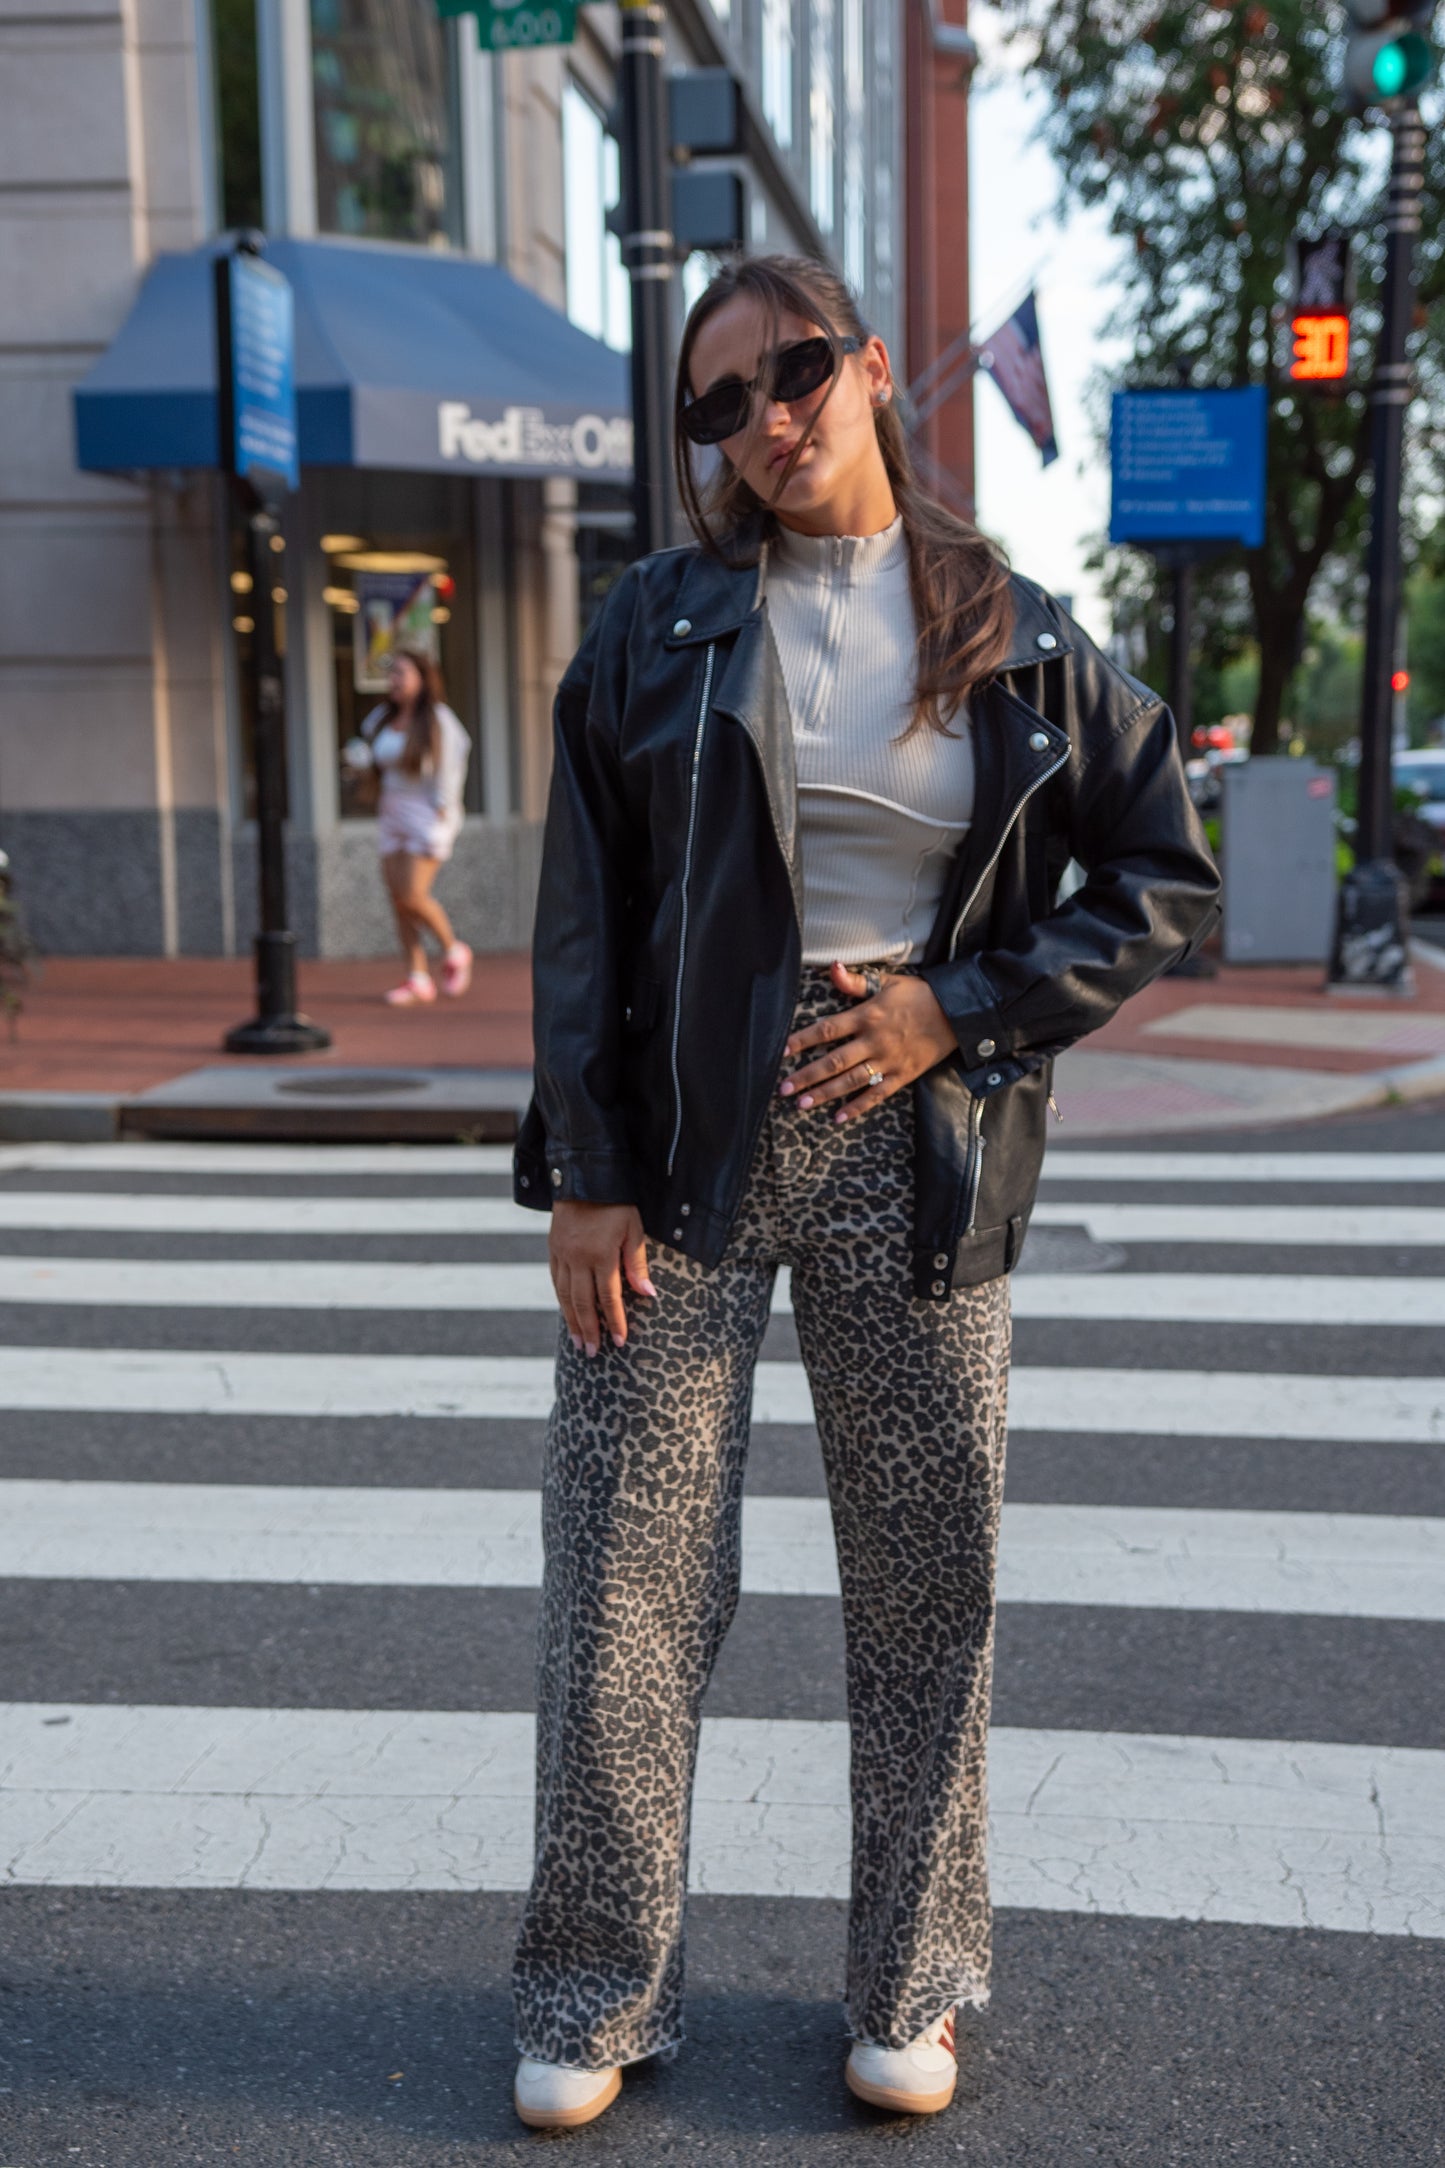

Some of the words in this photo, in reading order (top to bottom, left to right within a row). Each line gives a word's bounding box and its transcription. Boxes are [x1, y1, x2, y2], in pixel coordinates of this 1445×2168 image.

[491, 9, 562, 47] 600
[1291, 315, 1348, 379] 30
[438, 401, 573, 467] FedEx
